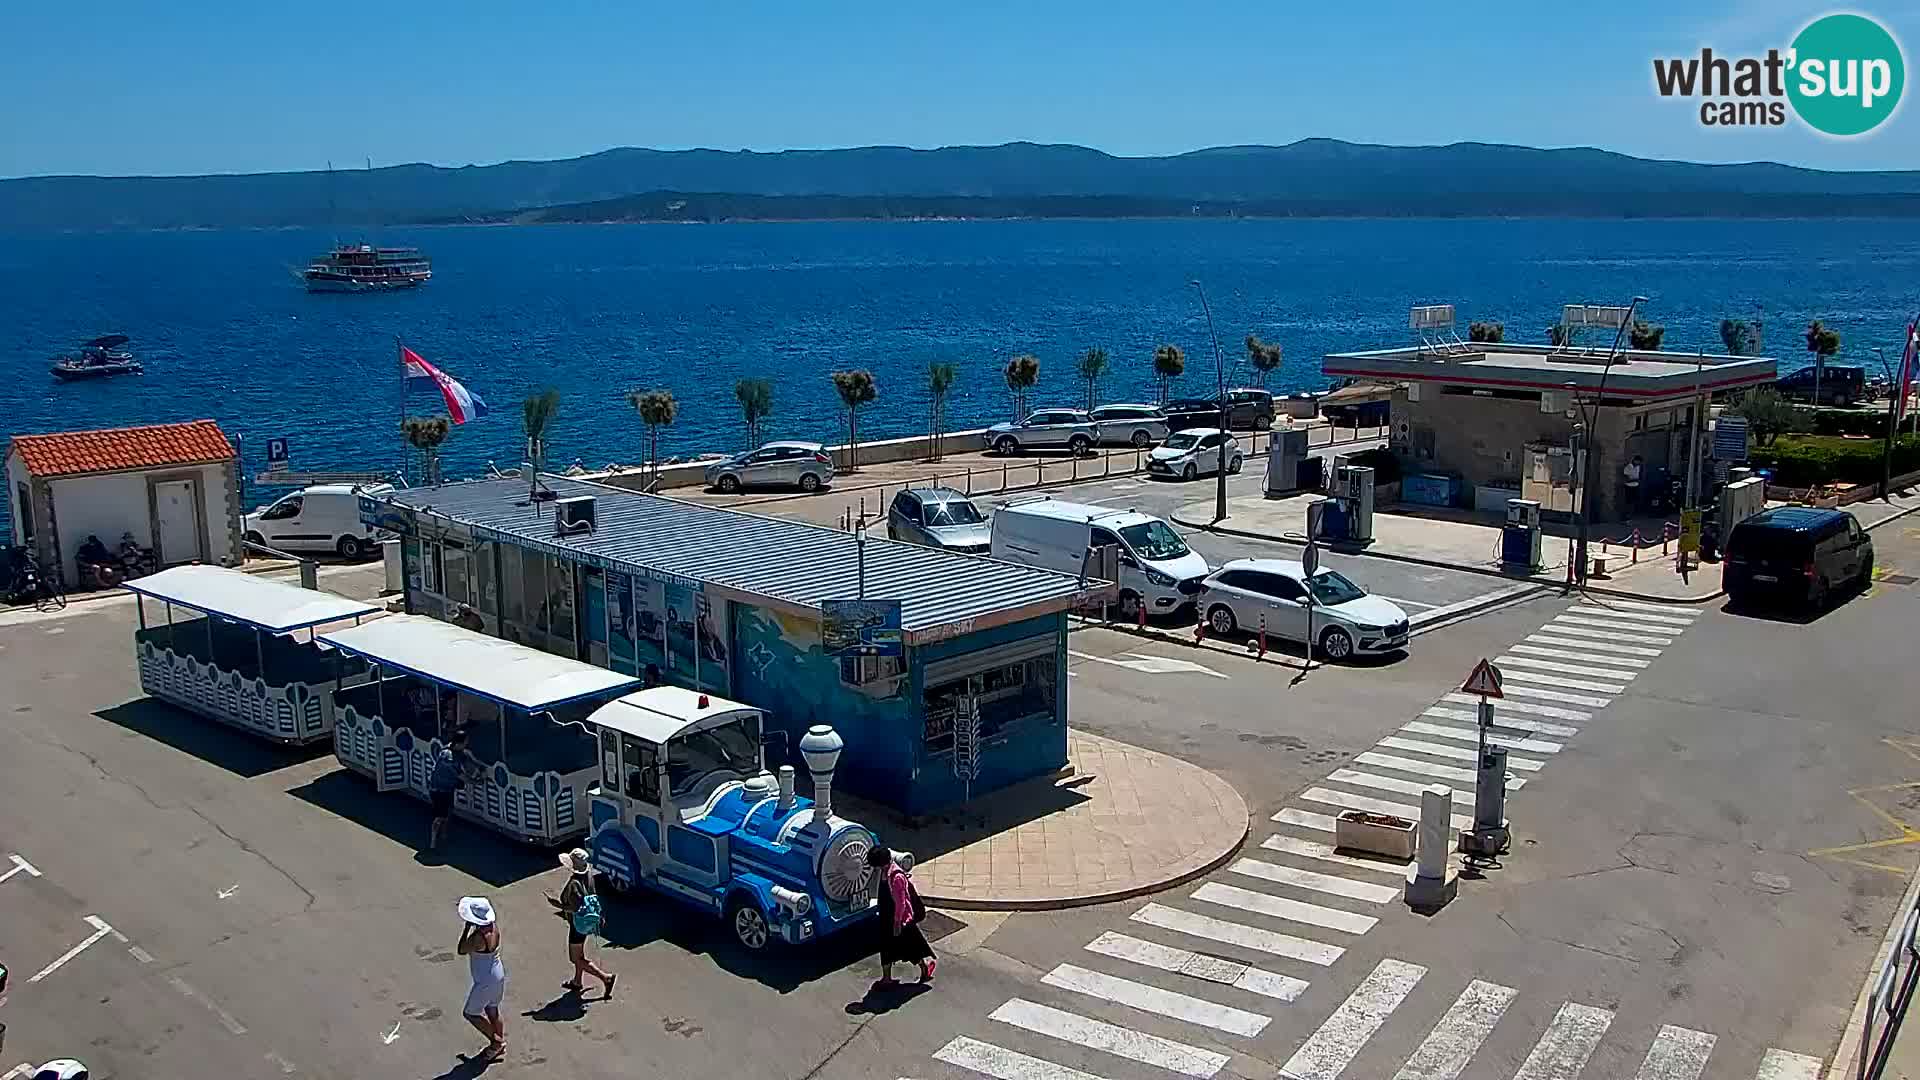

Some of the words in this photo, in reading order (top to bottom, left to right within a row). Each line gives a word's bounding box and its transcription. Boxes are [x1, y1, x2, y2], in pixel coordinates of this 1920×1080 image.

[272, 441, 283, 459] P
[615, 562, 646, 576] STATION
[649, 569, 673, 583] TICKET
[674, 575, 700, 589] OFFICE
